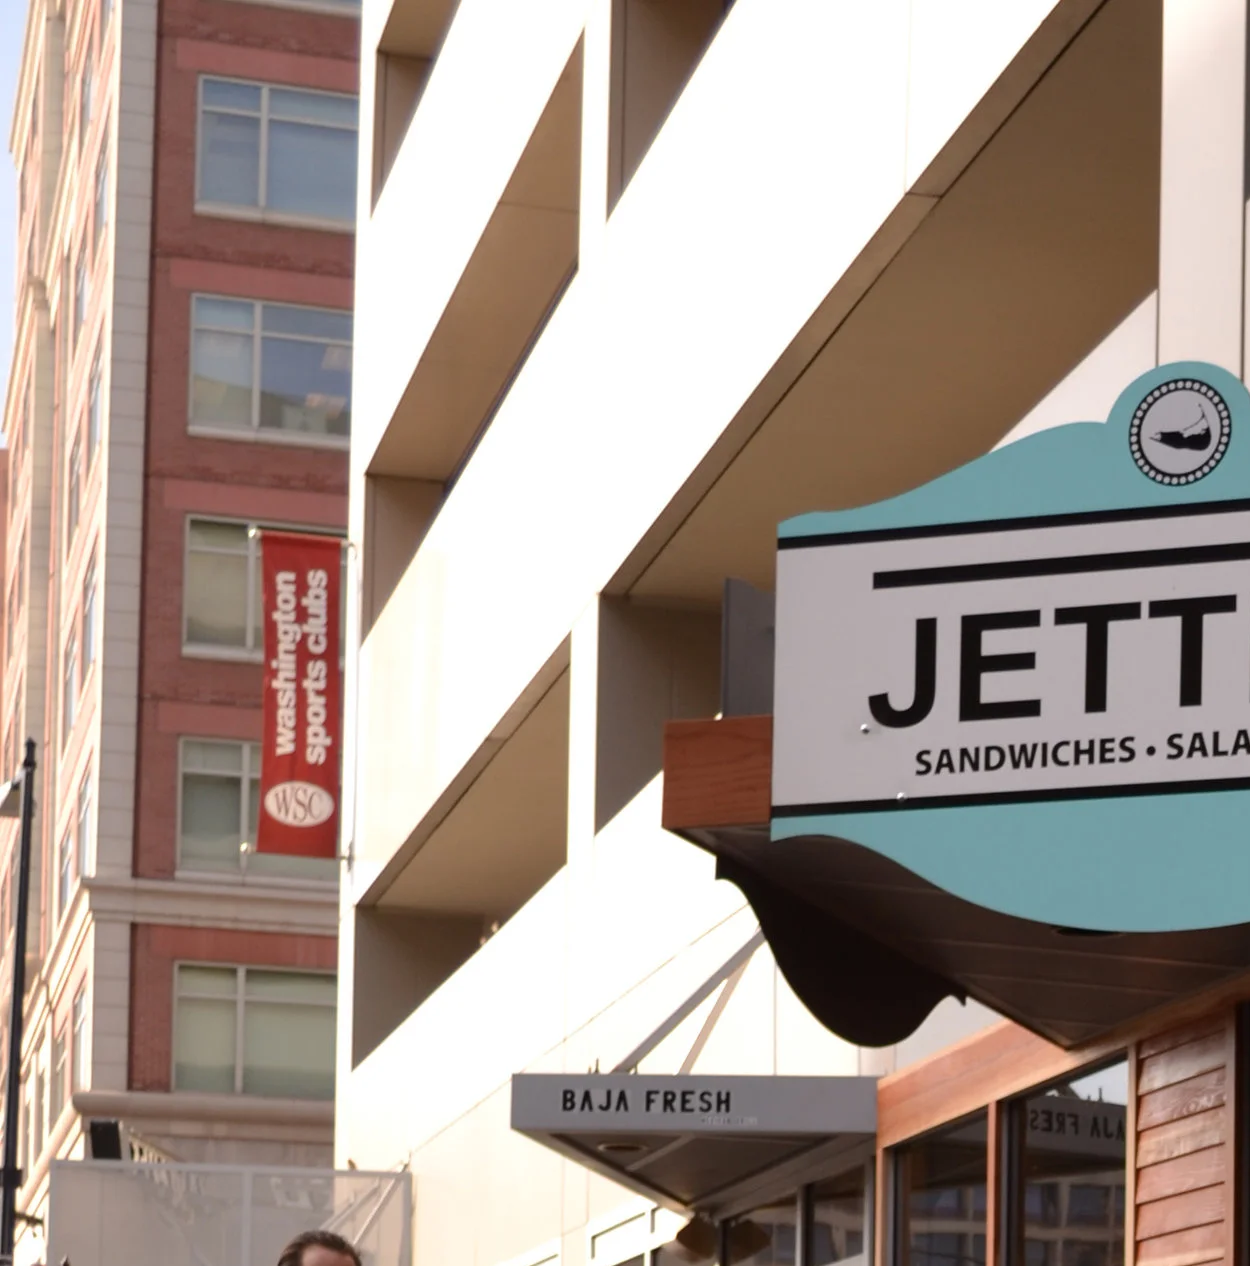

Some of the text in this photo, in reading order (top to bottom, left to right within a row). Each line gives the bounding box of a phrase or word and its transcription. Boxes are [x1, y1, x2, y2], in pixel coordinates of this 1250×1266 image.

[271, 570, 300, 757] washington
[301, 568, 331, 766] sports clubs
[915, 735, 1137, 776] SANDWICHES
[275, 783, 324, 823] WSC
[561, 1088, 731, 1114] BAJA FRESH
